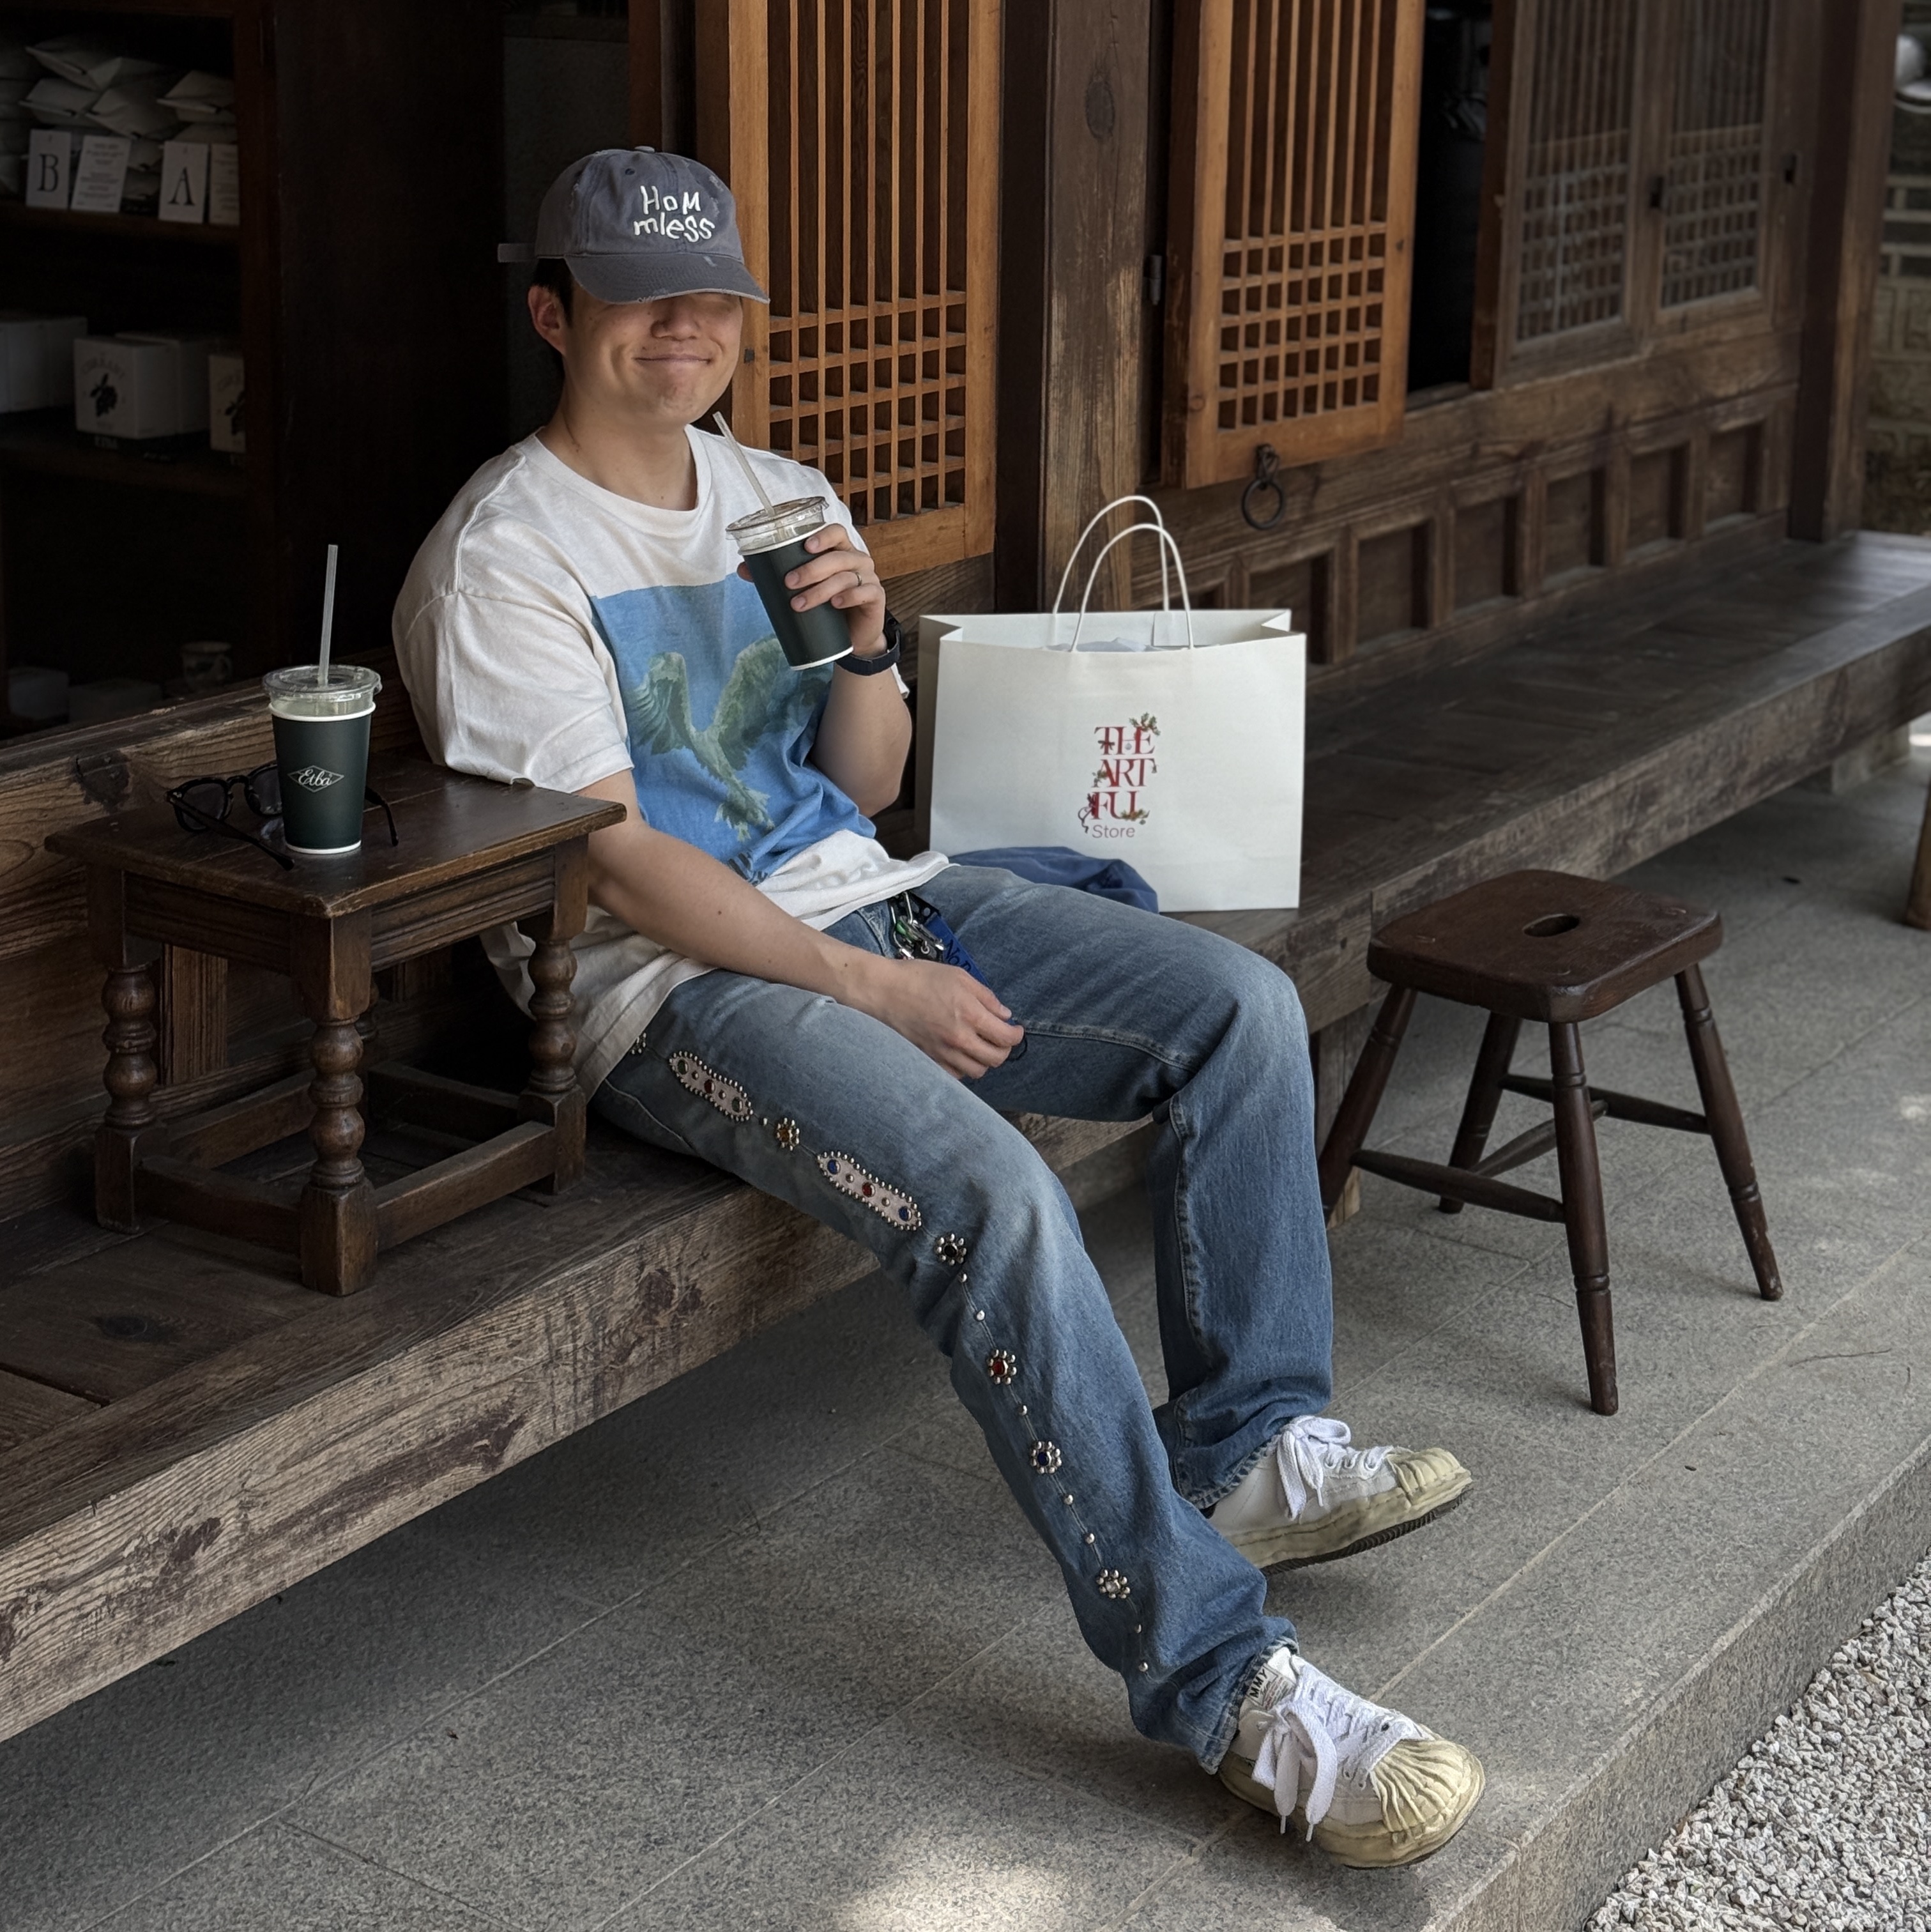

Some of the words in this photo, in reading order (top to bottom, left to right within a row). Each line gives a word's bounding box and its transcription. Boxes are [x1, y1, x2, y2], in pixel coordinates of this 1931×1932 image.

[37, 153, 59, 192] B
[167, 166, 195, 206] A
[1094, 726, 1156, 755] THE
[1091, 758, 1157, 788] ART
[1092, 825, 1136, 839] Store
[1249, 1668, 1268, 1699] MMY
